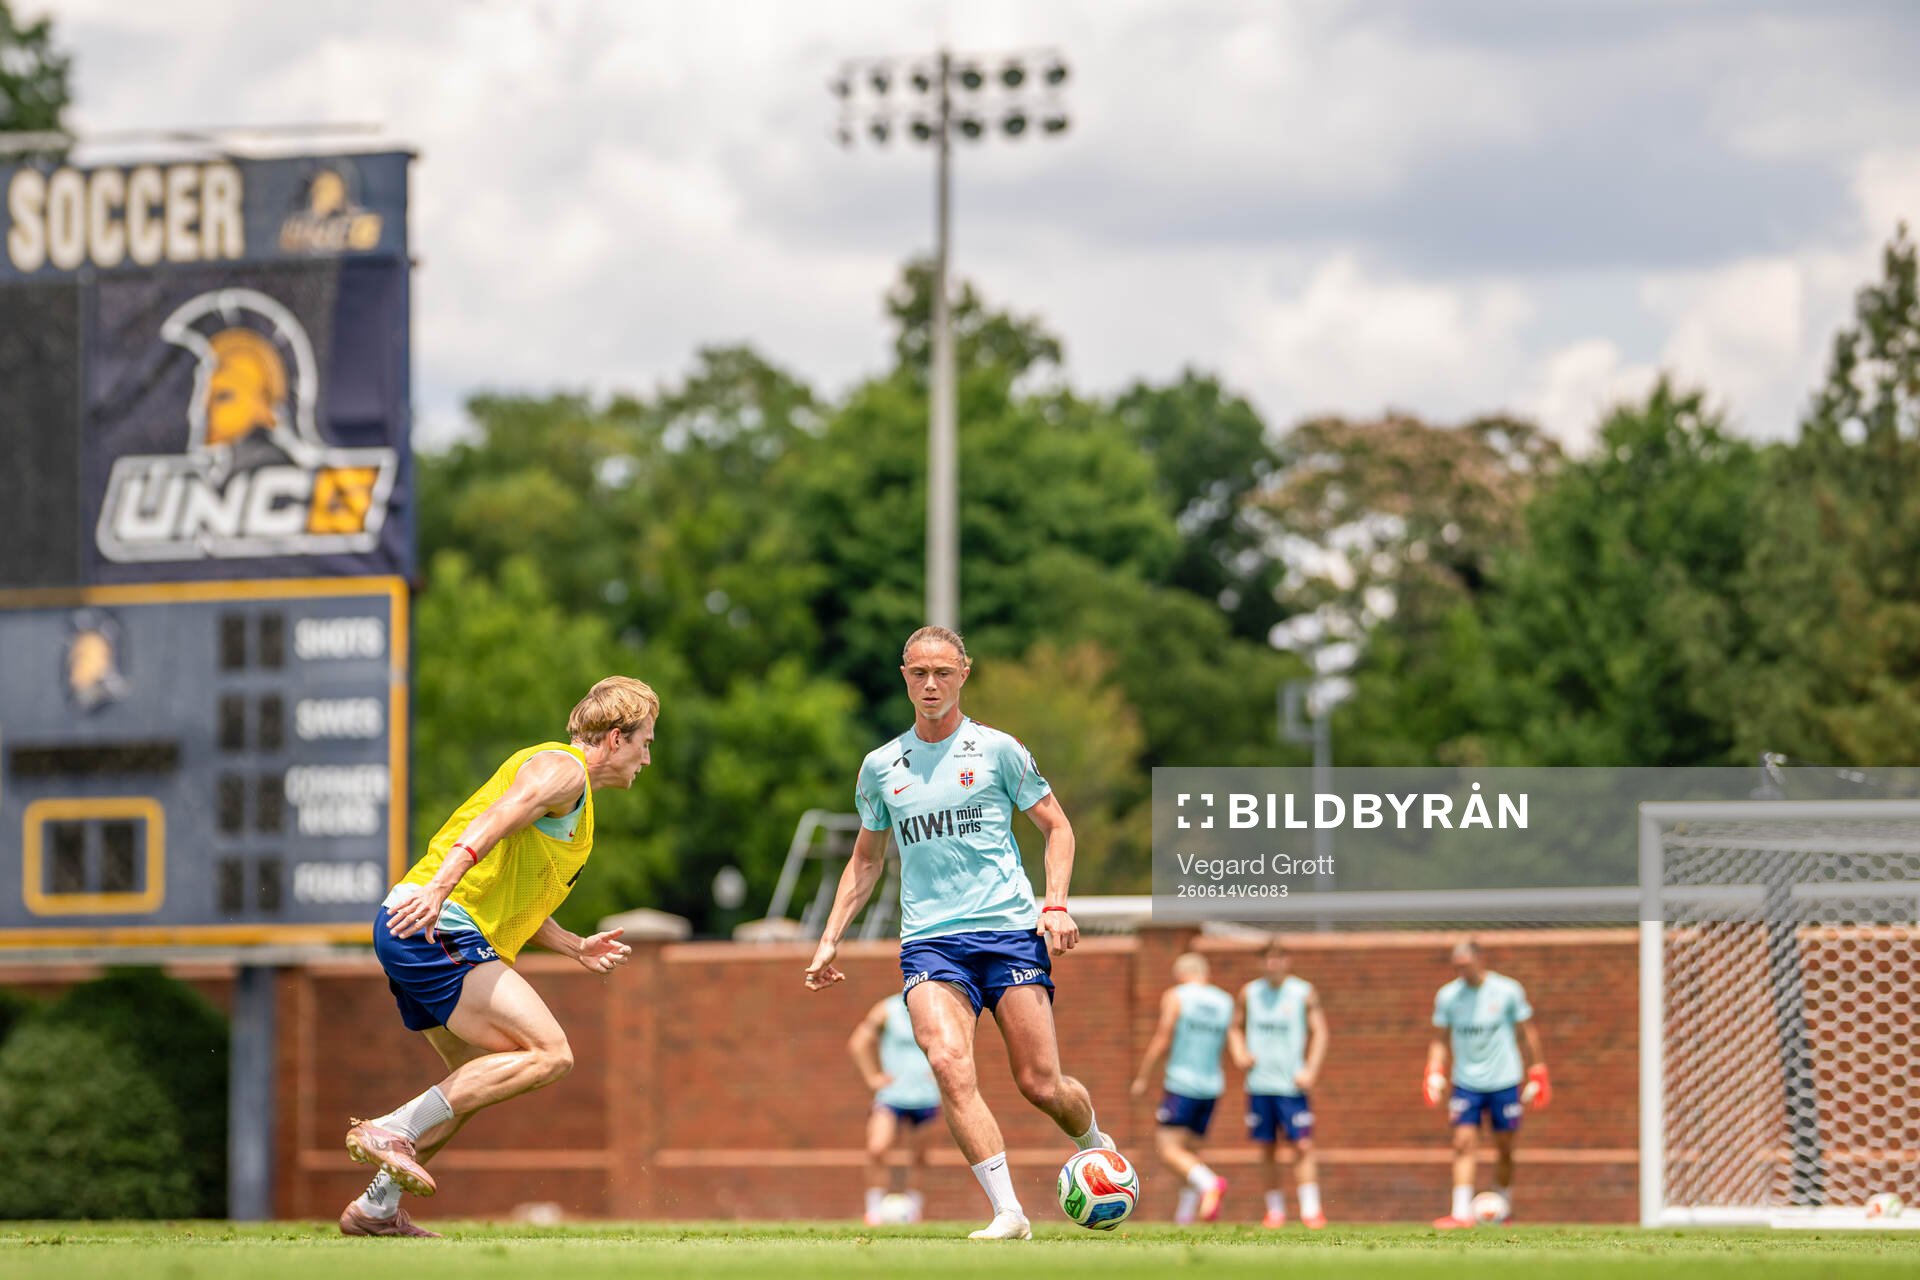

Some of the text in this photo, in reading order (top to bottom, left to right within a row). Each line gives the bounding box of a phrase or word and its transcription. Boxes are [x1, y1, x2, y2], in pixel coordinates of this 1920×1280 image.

[8, 161, 245, 272] SOCCER
[957, 805, 982, 821] mini
[899, 810, 954, 846] KIWI
[958, 820, 982, 838] pris
